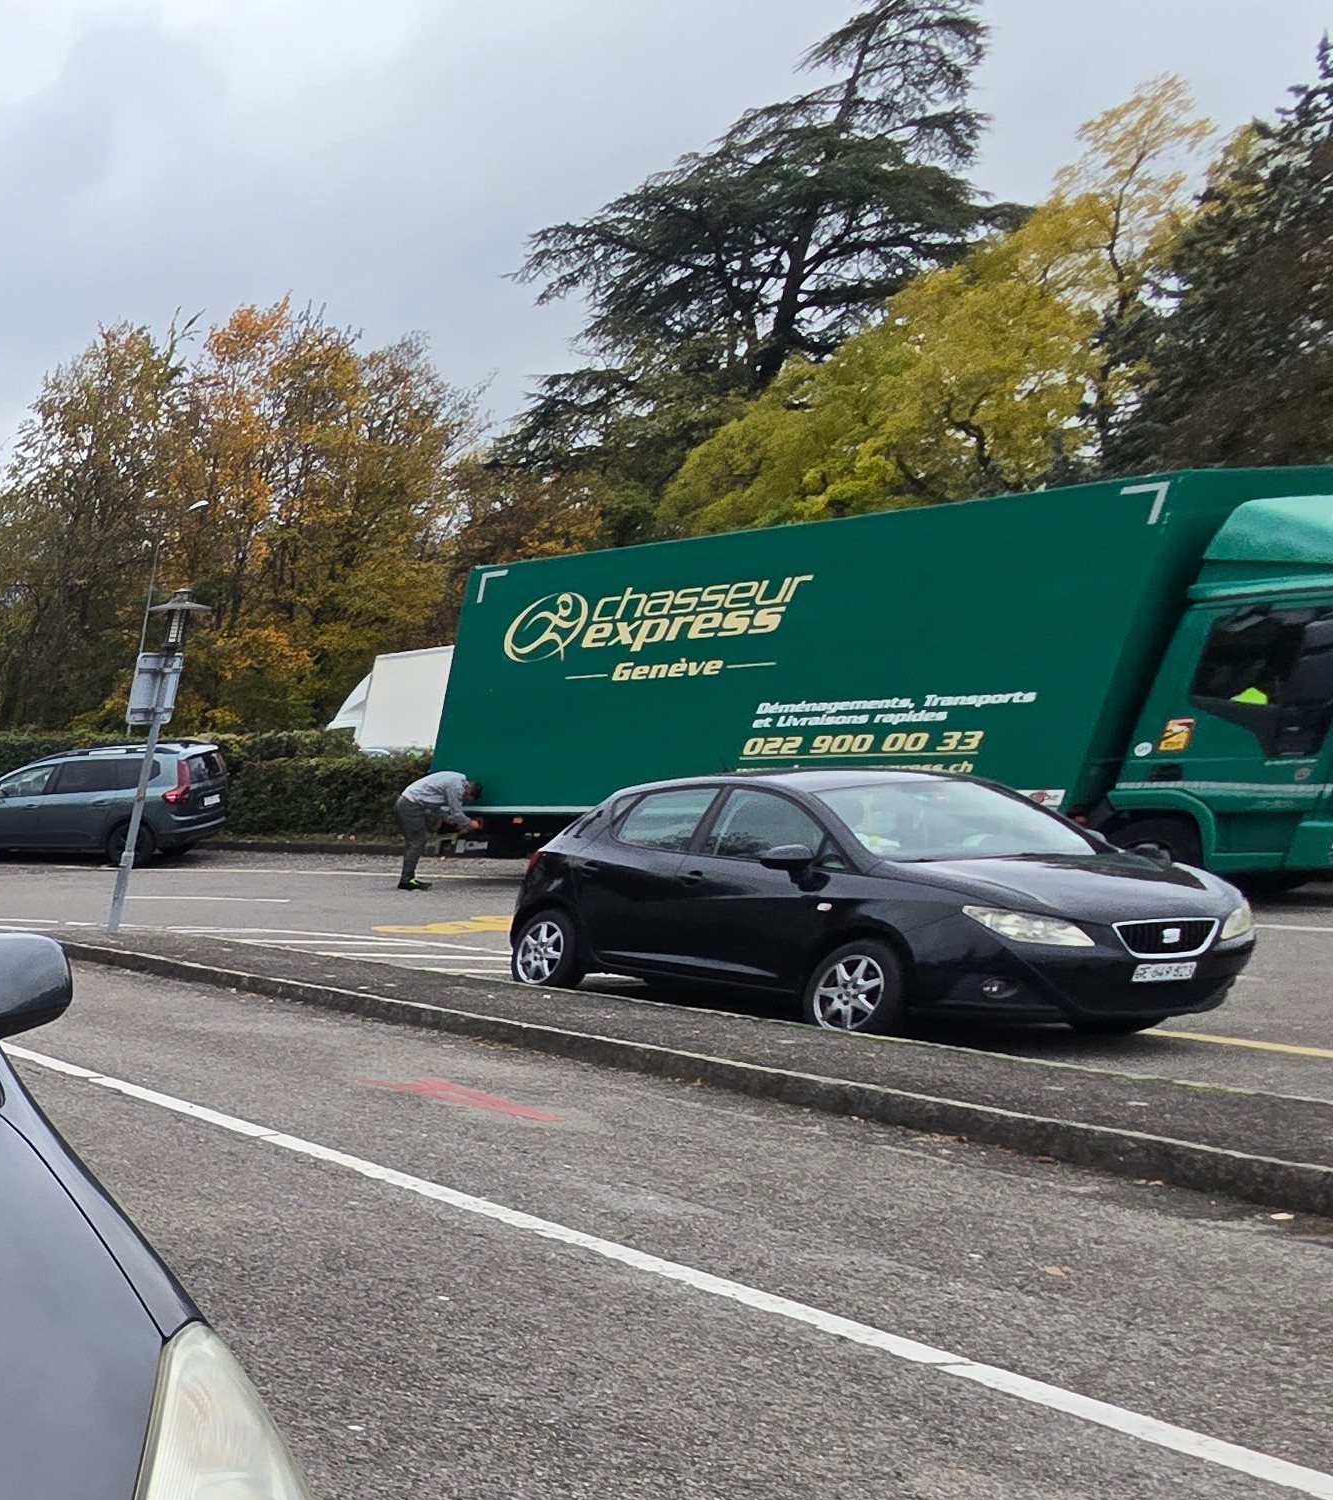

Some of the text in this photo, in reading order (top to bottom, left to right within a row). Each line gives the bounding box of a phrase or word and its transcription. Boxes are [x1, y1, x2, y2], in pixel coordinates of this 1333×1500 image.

[592, 574, 814, 622] chasseur
[582, 605, 787, 652] express
[611, 658, 724, 681] Genève
[924, 691, 1037, 707] Transports
[752, 710, 948, 728] et Livraisons rapides
[743, 730, 984, 756] 022 900 00 33
